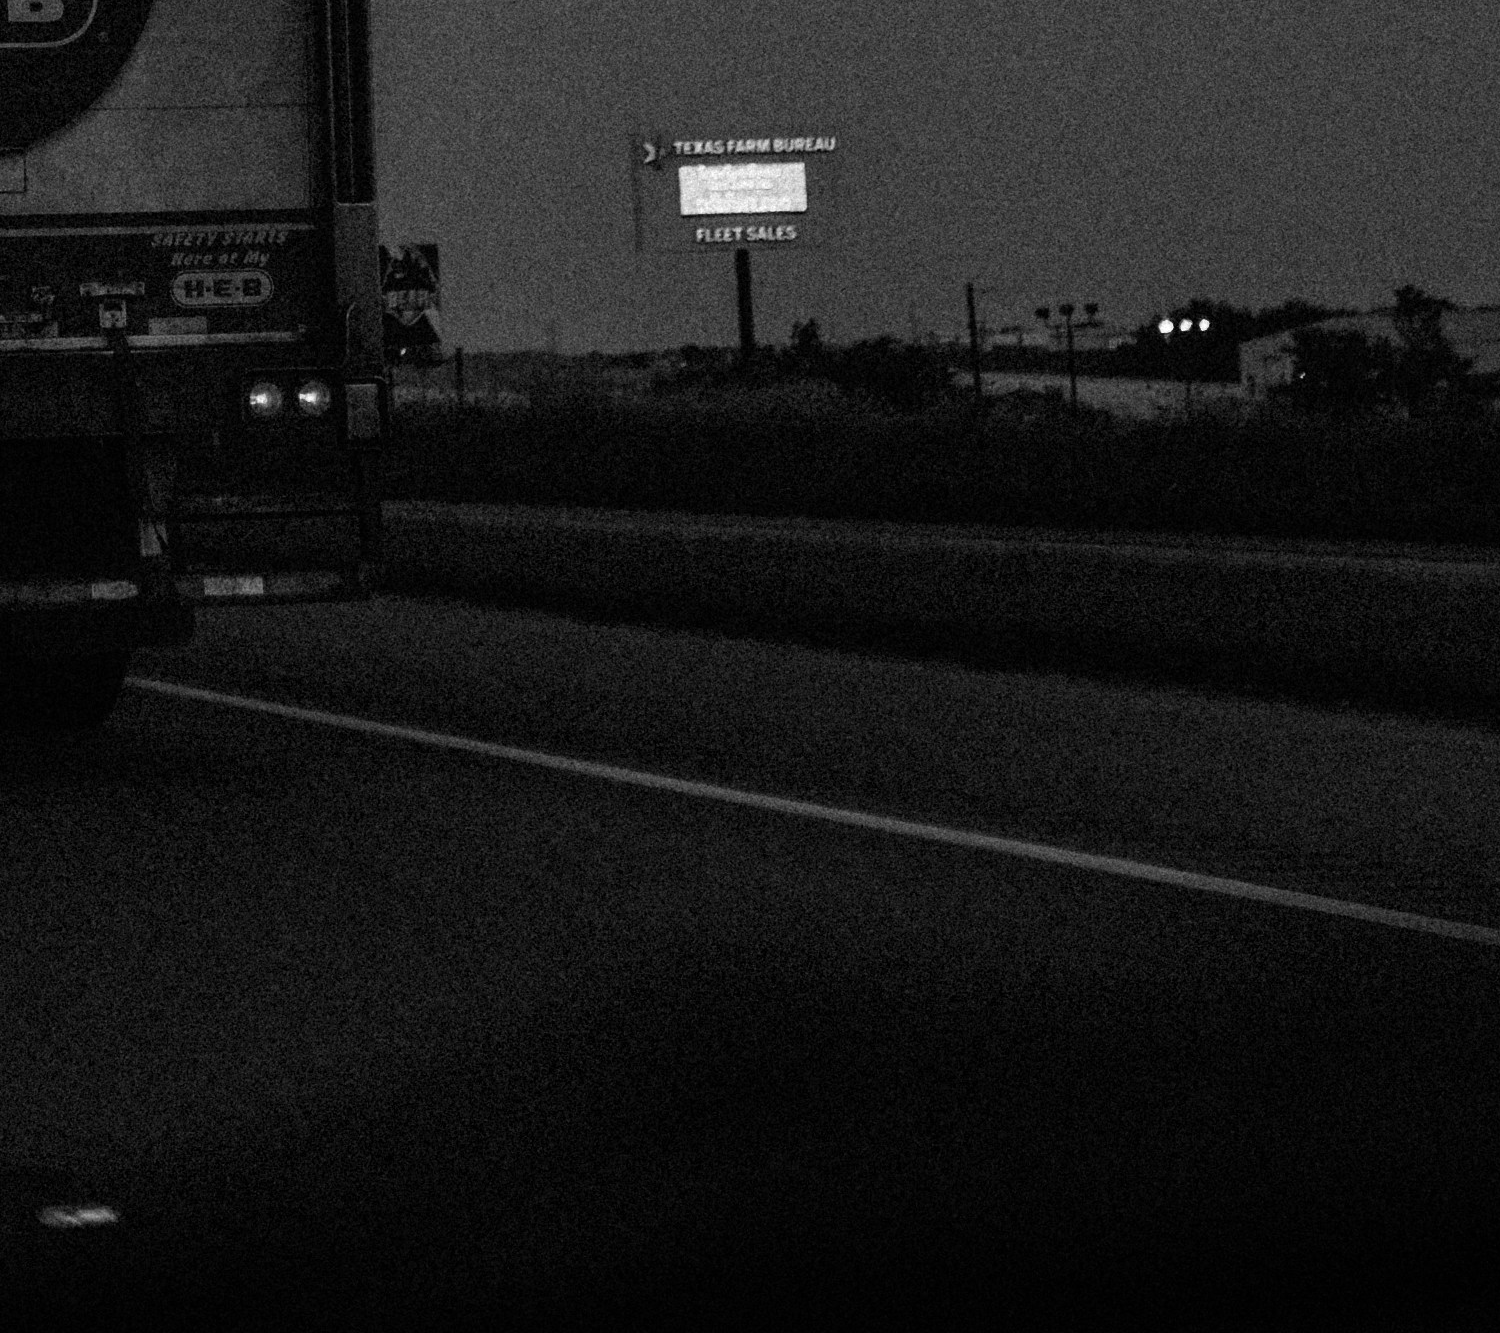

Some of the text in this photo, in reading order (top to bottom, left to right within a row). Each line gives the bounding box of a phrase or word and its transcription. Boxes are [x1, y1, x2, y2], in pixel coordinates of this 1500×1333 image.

[673, 136, 836, 155] TEXAS FARM BUREAU
[151, 229, 289, 247] SAFETY STARTS
[696, 225, 797, 243] FLEET SALES
[170, 252, 213, 266] Here
[243, 250, 270, 267] My
